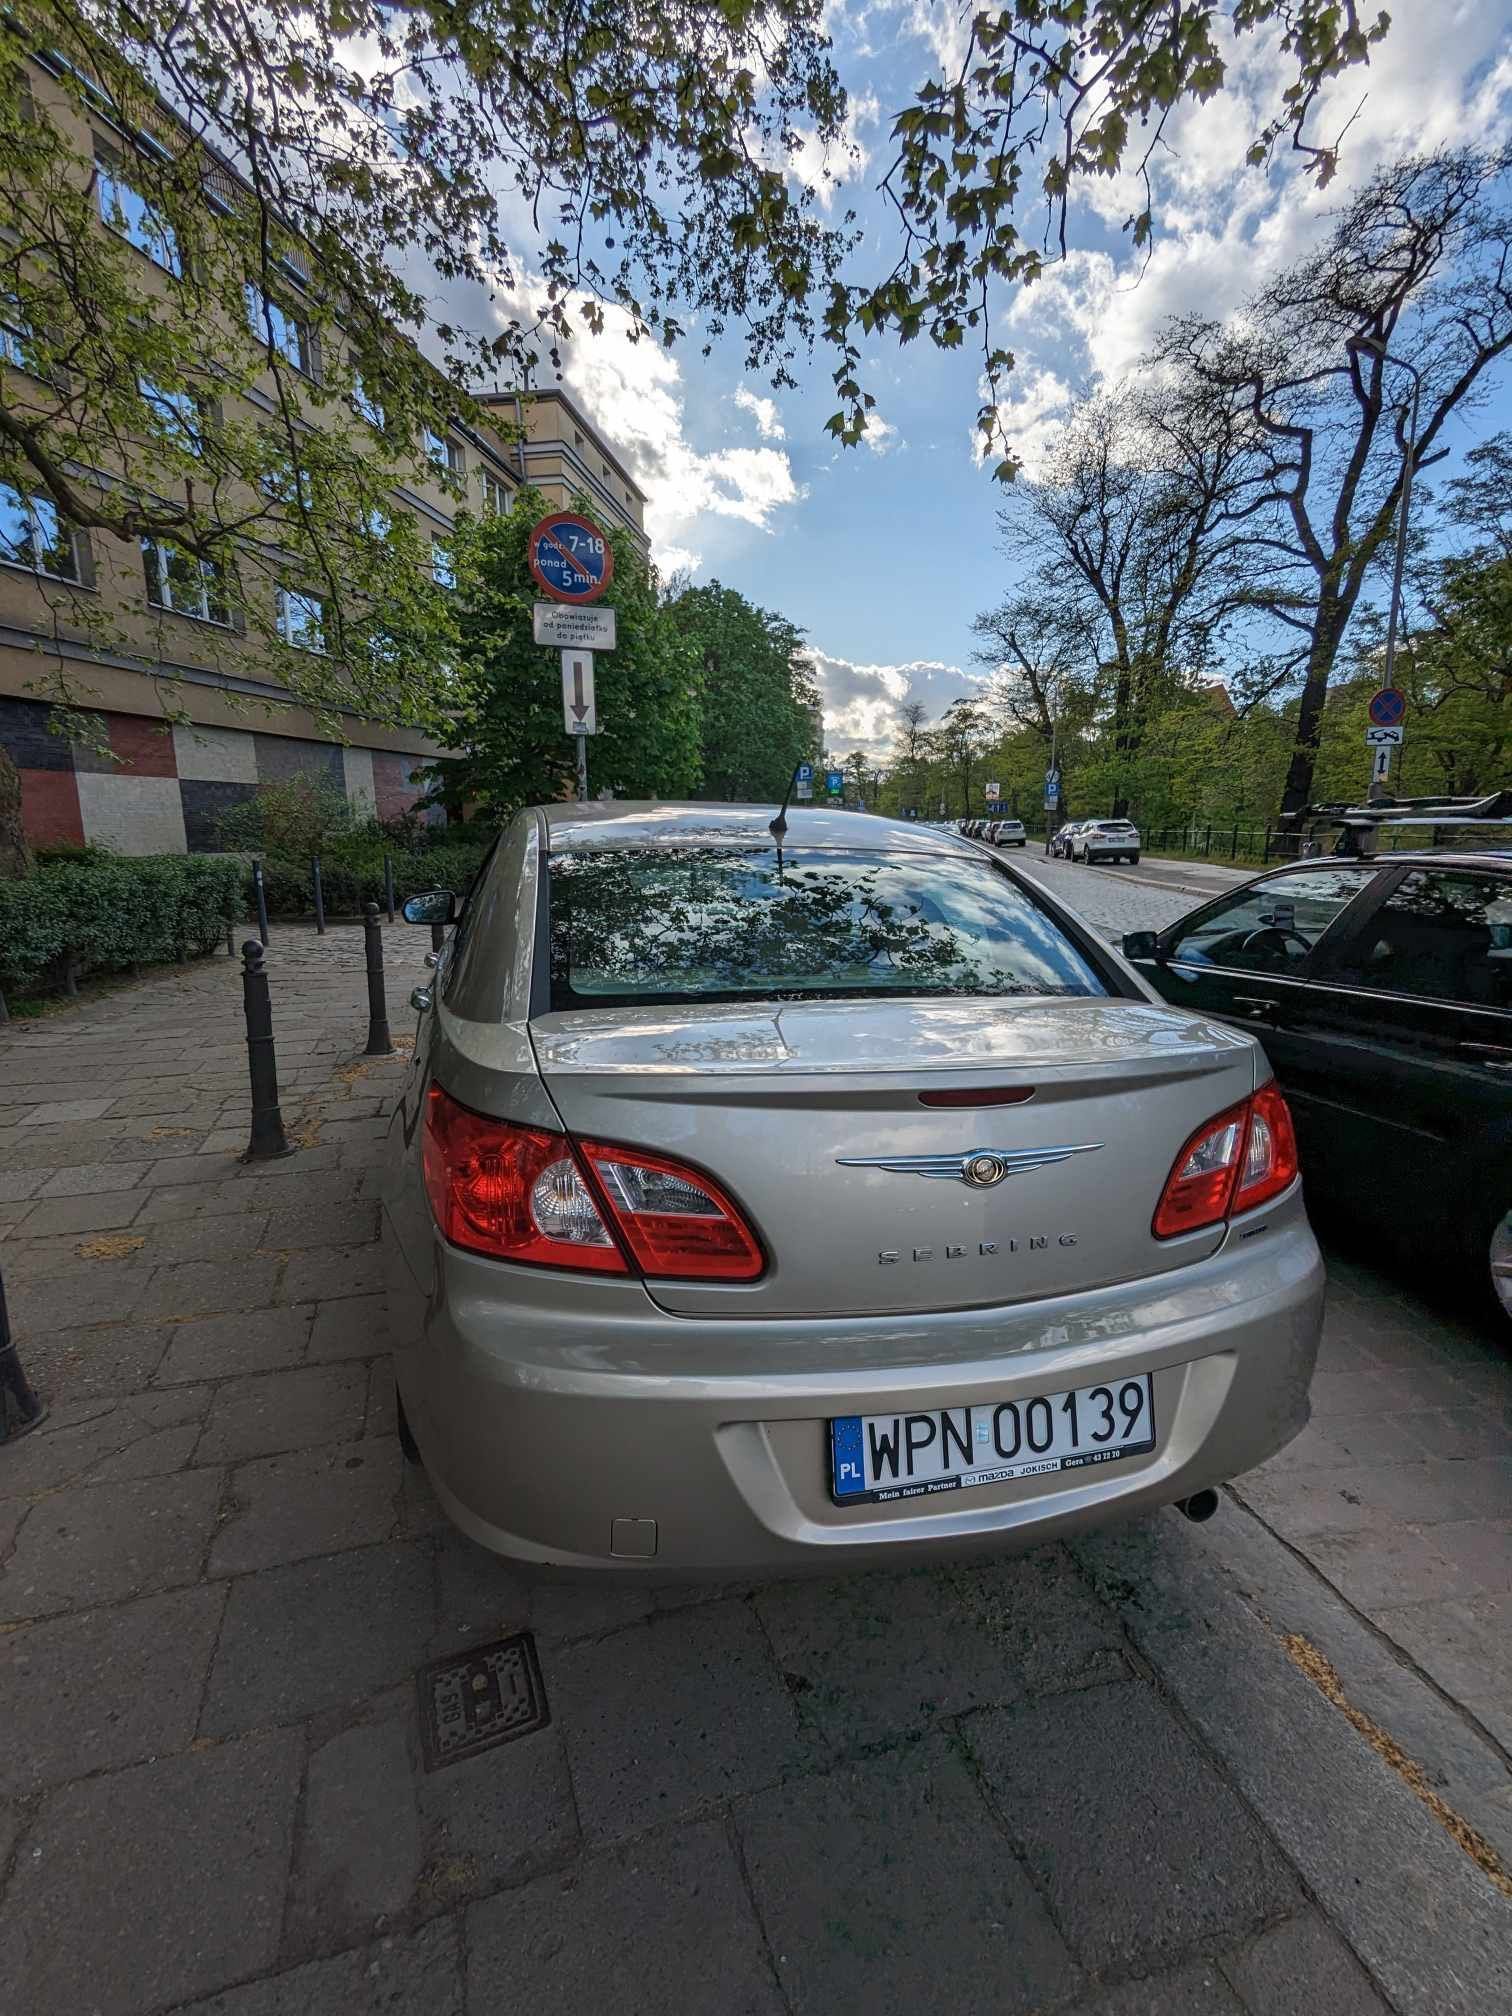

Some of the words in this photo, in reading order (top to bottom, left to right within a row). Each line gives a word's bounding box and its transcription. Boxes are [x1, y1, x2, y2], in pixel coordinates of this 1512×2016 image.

[568, 535, 605, 554] 7-18
[533, 558, 567, 569] ponad
[562, 570, 573, 587] 5
[574, 571, 602, 584] min.
[543, 621, 554, 629] od
[556, 632, 568, 640] do
[800, 766, 810, 780] P
[1048, 783, 1057, 795] P
[878, 1232, 1079, 1265] SEBRING
[867, 1407, 974, 1481] WPN
[993, 1381, 1145, 1459] 00139
[840, 1463, 861, 1480] PL
[879, 1490, 900, 1500] Mein
[902, 1485, 925, 1497] fairer
[927, 1481, 957, 1493] Partner
[978, 1468, 1014, 1484] mazda
[1020, 1461, 1058, 1475] JOKISCH
[1064, 1458, 1083, 1468] Gera
